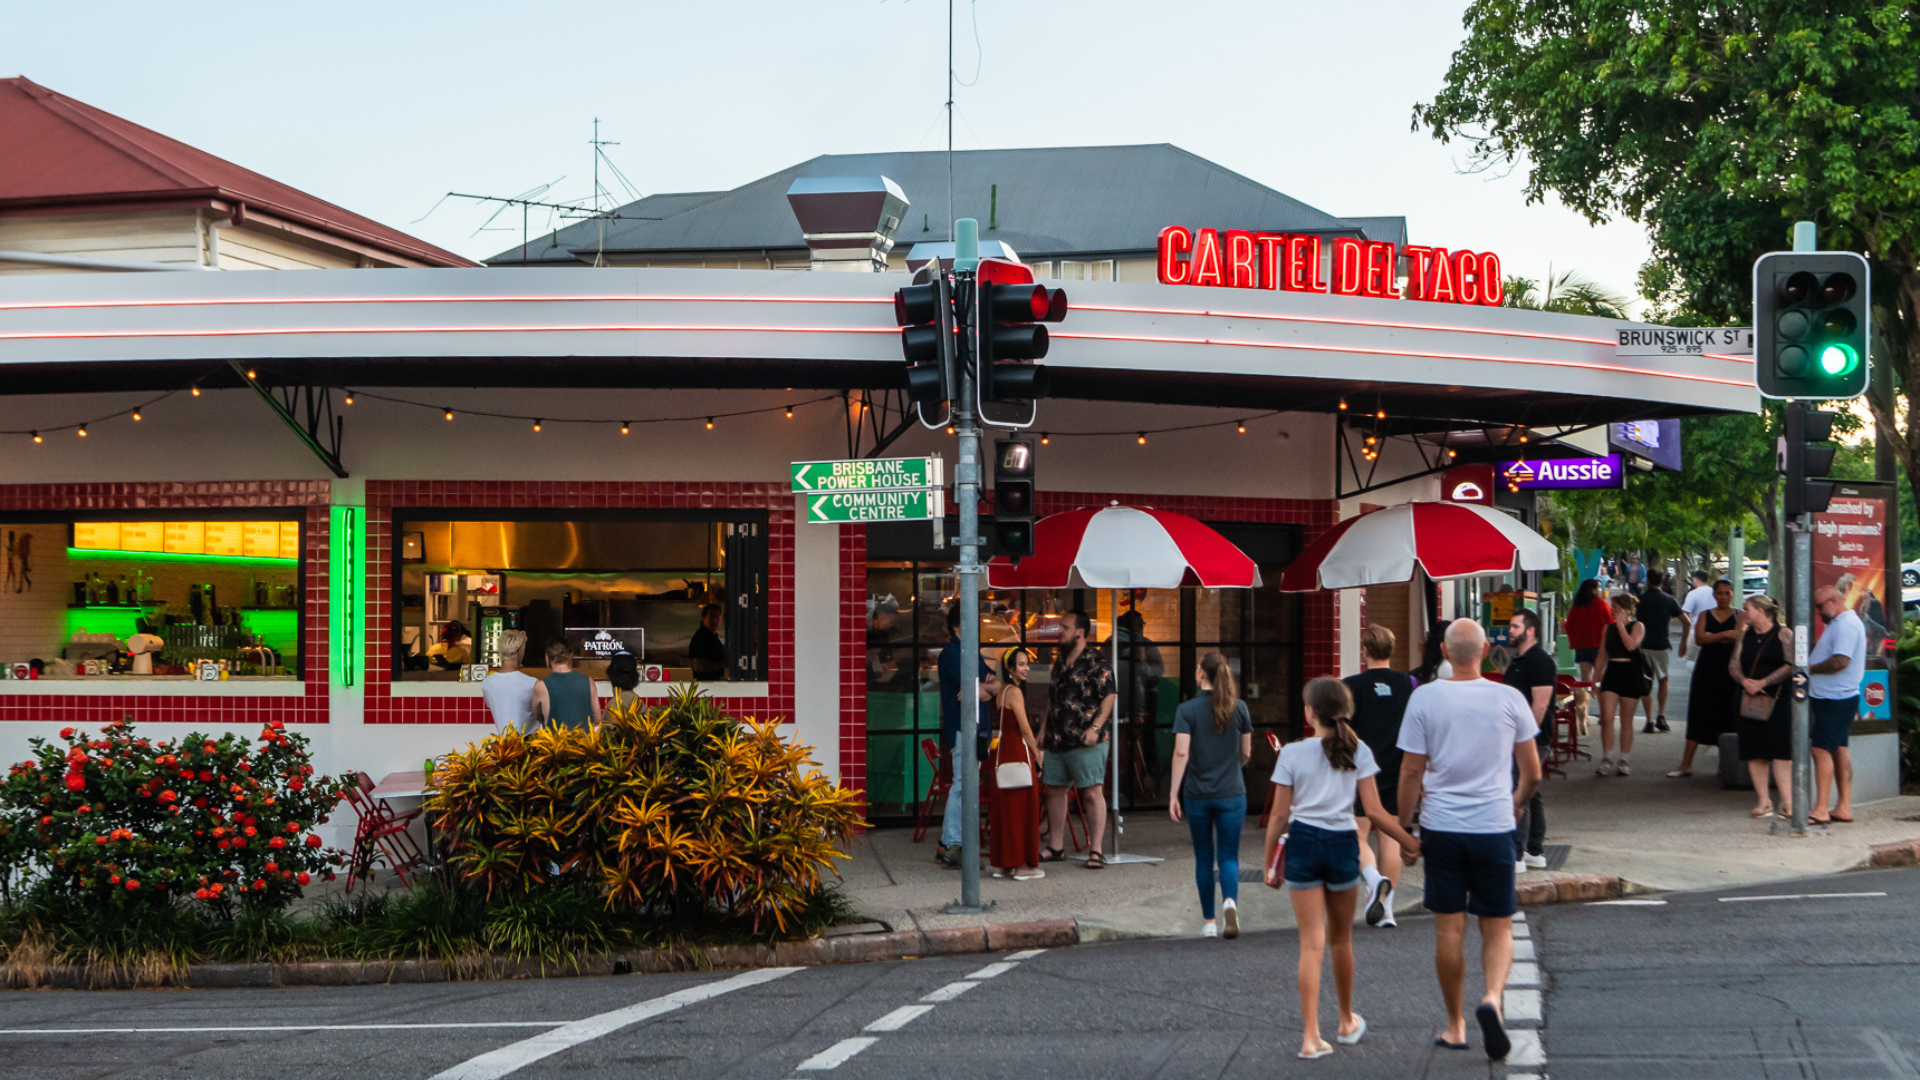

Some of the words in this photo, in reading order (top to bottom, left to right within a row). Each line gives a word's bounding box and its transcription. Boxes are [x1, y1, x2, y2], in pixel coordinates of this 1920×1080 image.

[1157, 226, 1326, 293] CARTEL
[1331, 238, 1400, 299] DEL
[1401, 245, 1504, 307] TACO
[1619, 330, 1716, 346] BRUNSWICK
[1723, 330, 1740, 345] ST
[1661, 345, 1677, 353] 925
[1686, 345, 1703, 353] 895
[832, 460, 905, 476] BRISBANE
[1538, 460, 1611, 480] Aussie
[817, 474, 867, 489] POWER
[871, 473, 921, 487] HOUSE
[832, 491, 921, 508] COMMUNITY
[848, 506, 906, 520] CENTRE
[1863, 501, 1874, 519] by
[1817, 520, 1837, 537] high
[1838, 521, 1882, 538] premiums?
